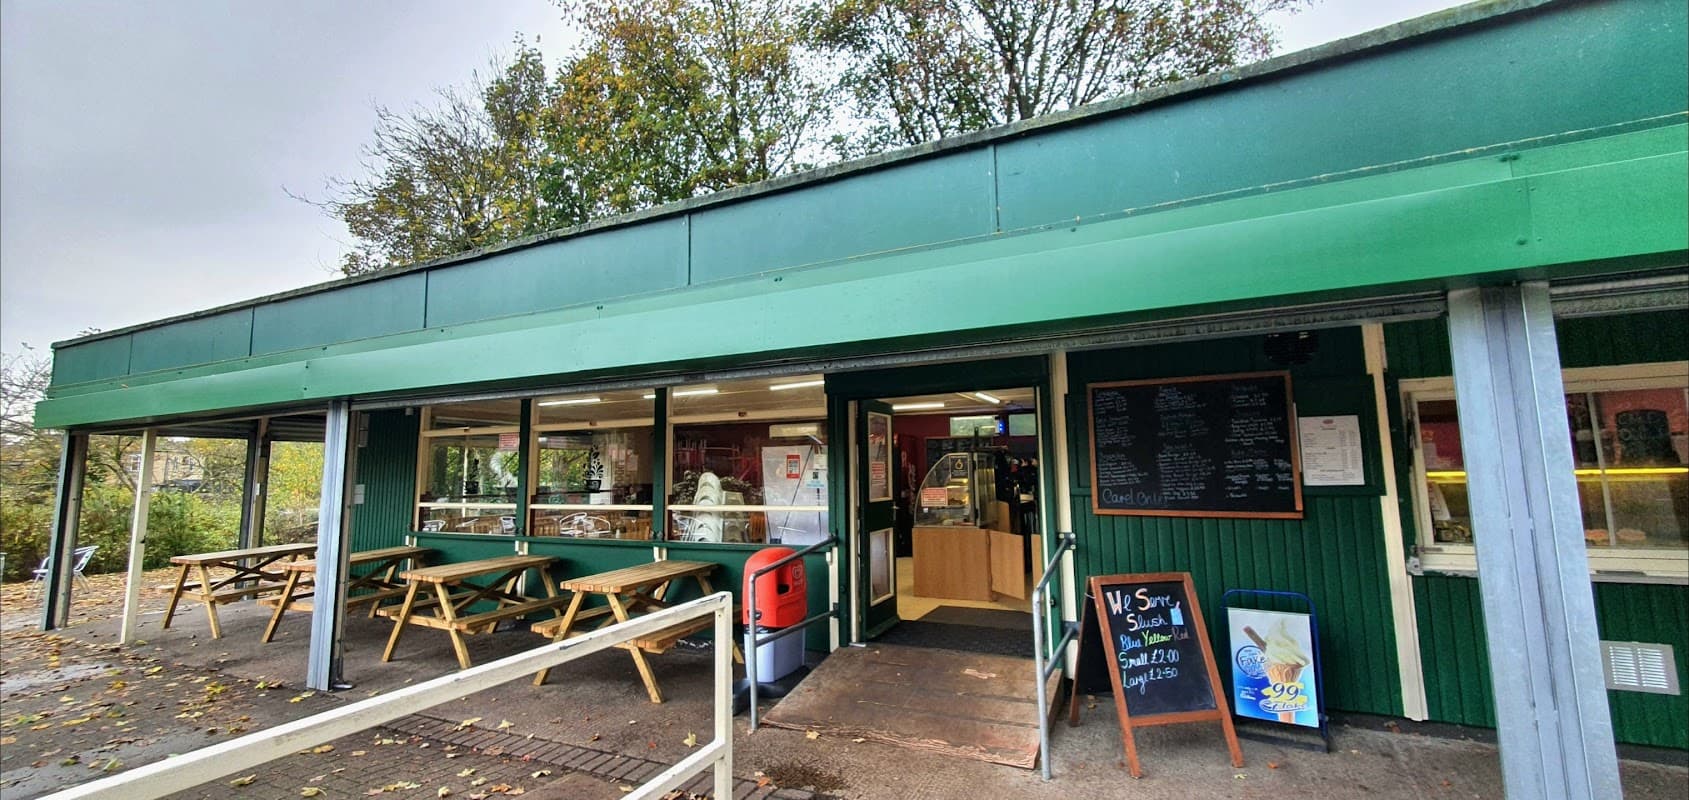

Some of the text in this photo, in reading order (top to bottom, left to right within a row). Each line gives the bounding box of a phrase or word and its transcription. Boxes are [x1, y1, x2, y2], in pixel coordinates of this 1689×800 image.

[1102, 488, 1134, 505] Card
[1106, 588, 1174, 615] We Serve
[1126, 613, 1168, 632] Slush
[1120, 628, 1190, 651] Blue Yellow Red
[1118, 651, 1149, 669] Small
[1123, 670, 1149, 695] Large
[1272, 682, 1300, 701] 99
